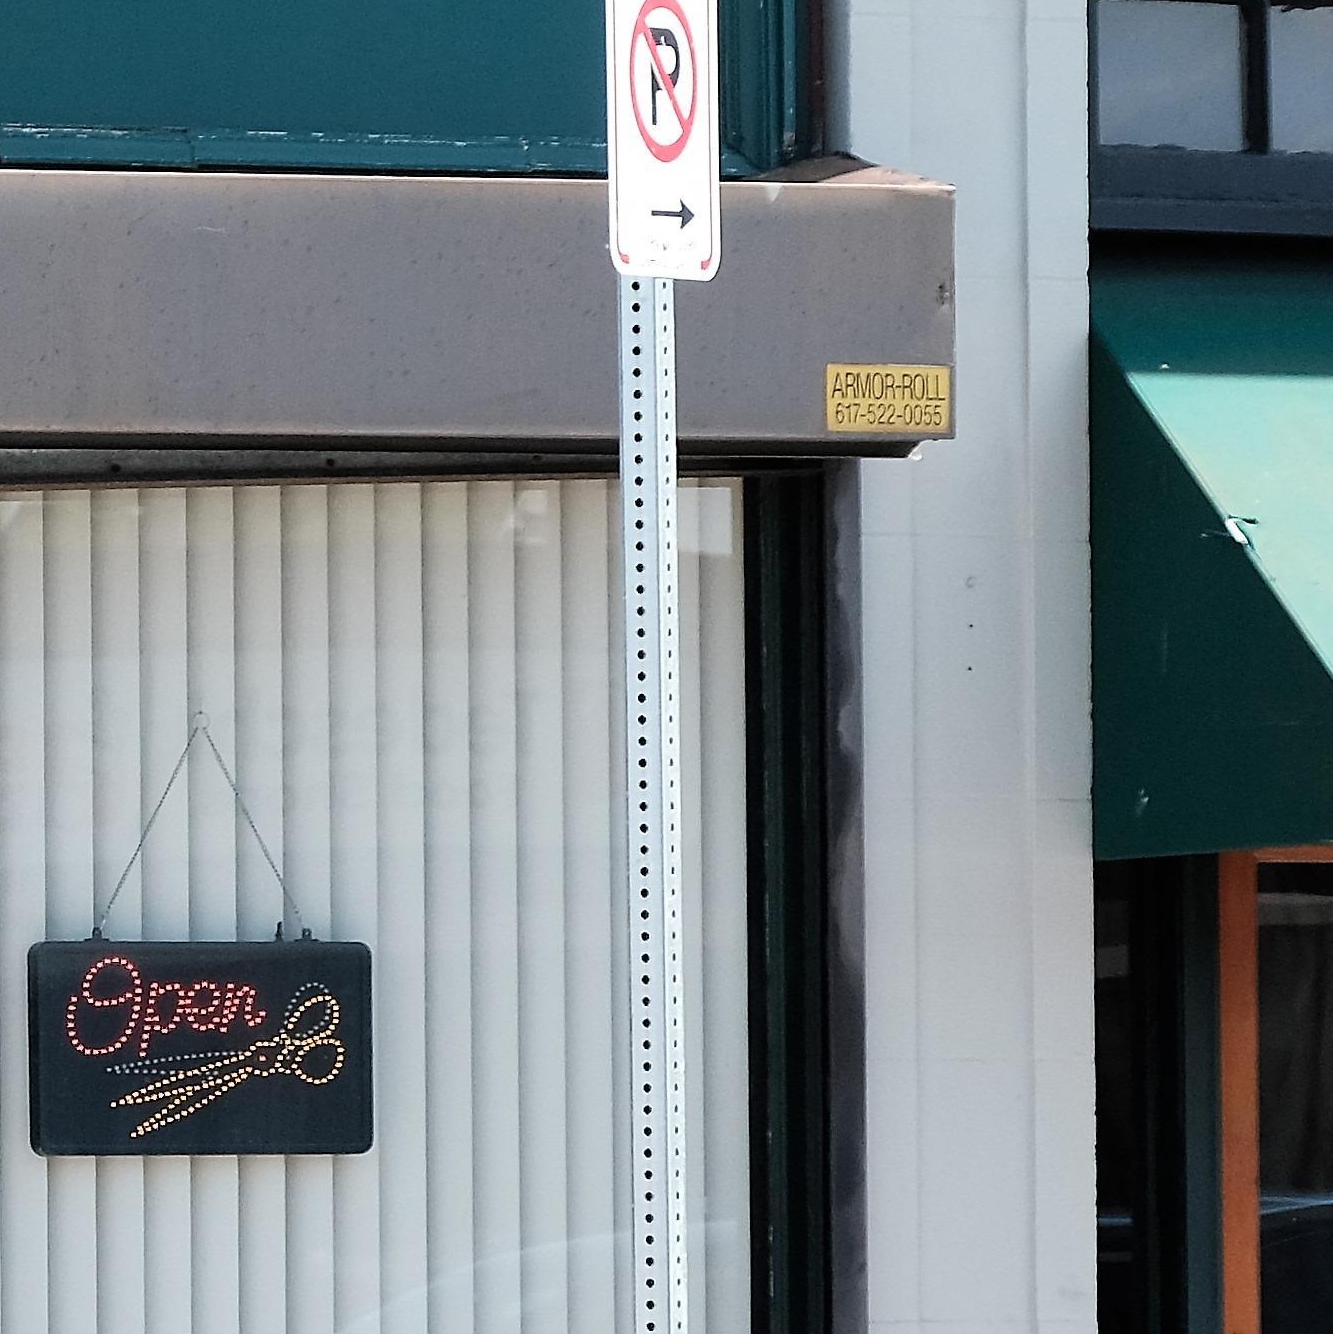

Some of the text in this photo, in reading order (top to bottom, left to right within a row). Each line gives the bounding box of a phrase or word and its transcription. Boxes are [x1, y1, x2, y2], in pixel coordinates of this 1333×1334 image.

[831, 371, 946, 402] ARMOR-ROLL
[835, 402, 943, 427] 617-522-0055
[65, 956, 268, 1058] Open
